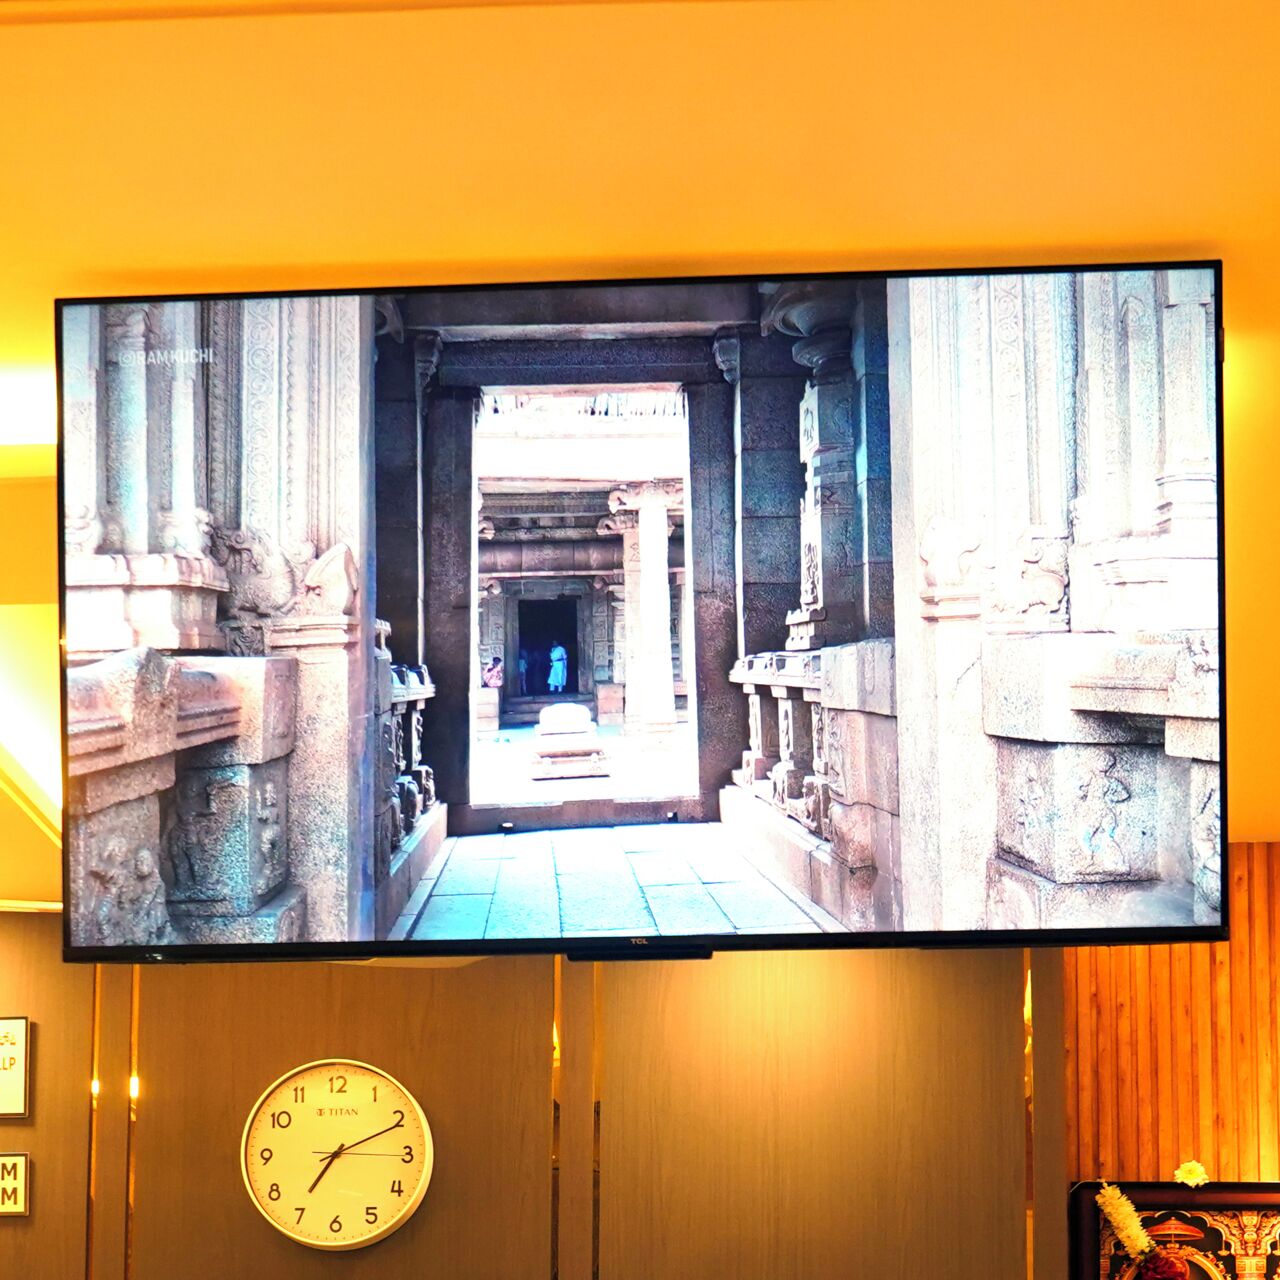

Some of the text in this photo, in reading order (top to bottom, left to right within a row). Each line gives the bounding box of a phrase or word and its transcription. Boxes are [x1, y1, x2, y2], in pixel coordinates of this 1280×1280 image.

[329, 1075, 347, 1093] 12
[293, 1086, 305, 1103] 11
[372, 1086, 377, 1102] 1
[271, 1111, 292, 1128] 10
[329, 1108, 359, 1116] TITAN
[392, 1110, 405, 1127] 2
[260, 1148, 273, 1165] 9
[401, 1145, 414, 1163] 3
[268, 1183, 281, 1201] 8
[390, 1180, 404, 1197] 4
[294, 1208, 305, 1224] 7
[365, 1206, 378, 1224] 5
[329, 1215, 342, 1233] 6
